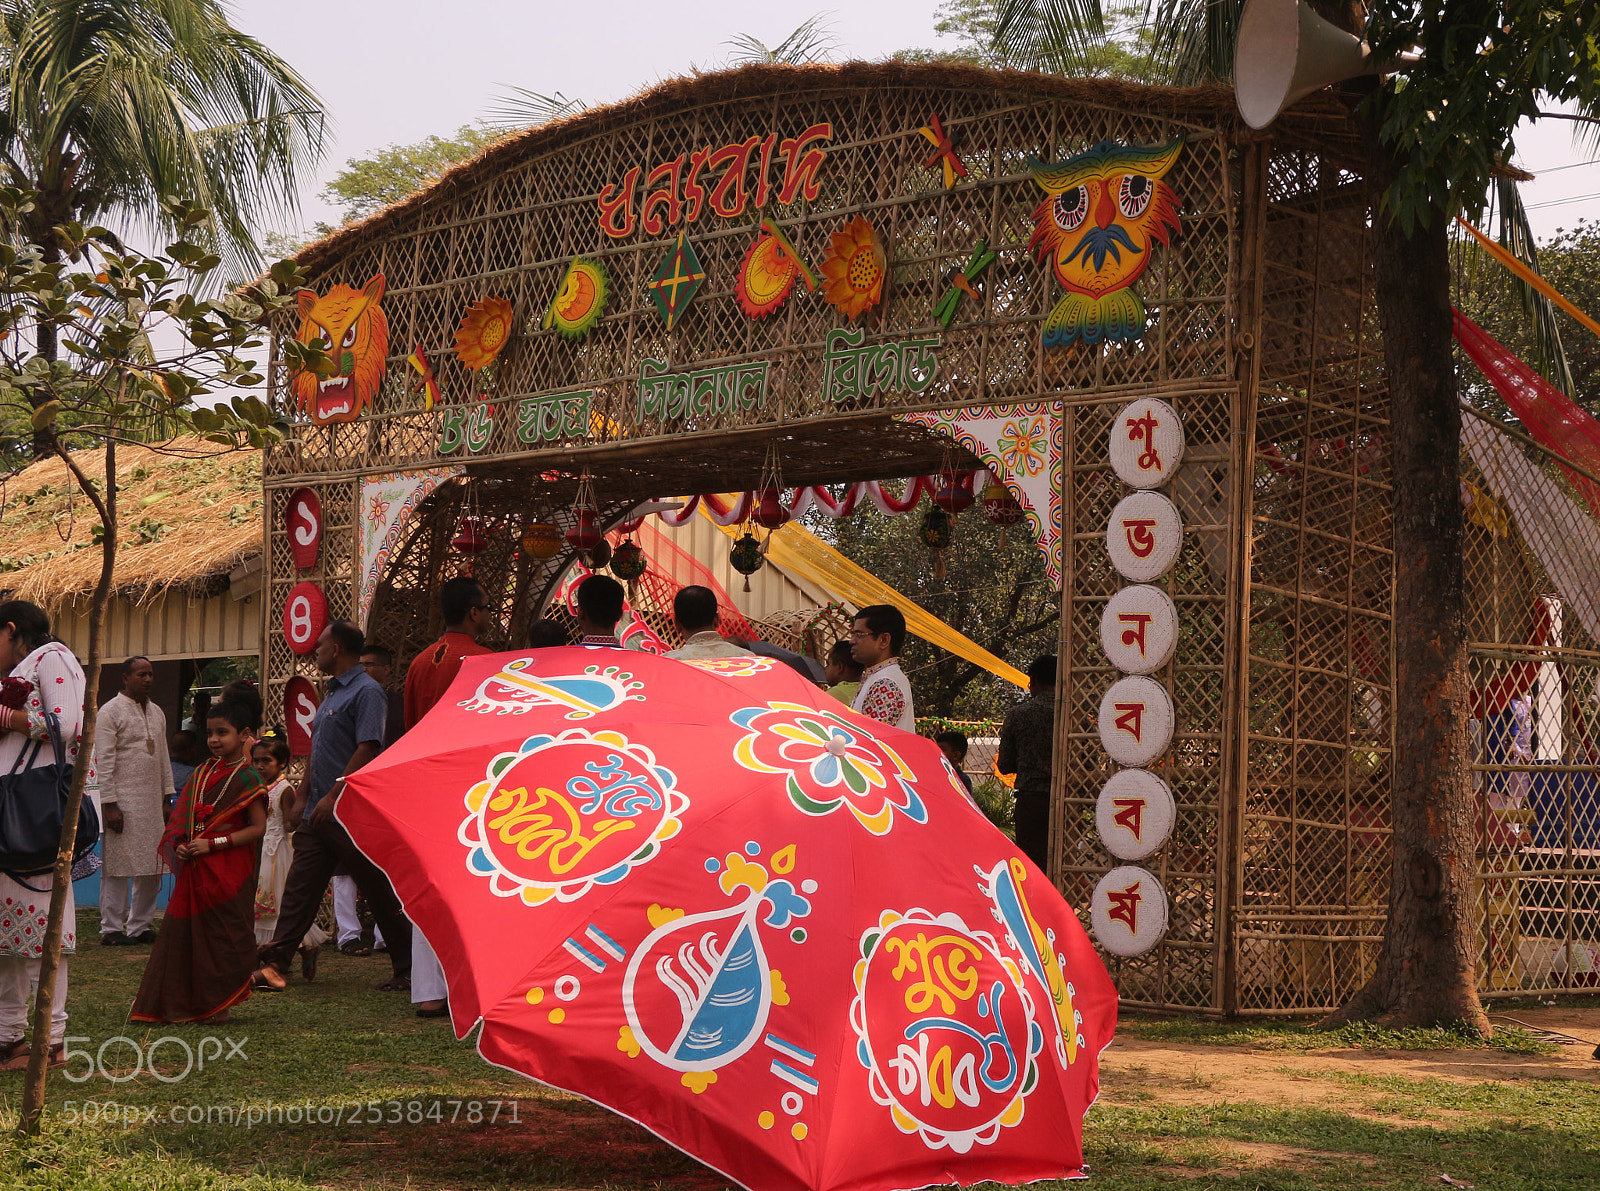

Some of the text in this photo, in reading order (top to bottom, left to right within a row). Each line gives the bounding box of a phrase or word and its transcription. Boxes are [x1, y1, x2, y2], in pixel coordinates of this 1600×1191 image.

[598, 122, 832, 238] ধন্যবাদ
[636, 358, 770, 425] সিগন্যাল
[821, 328, 940, 402] ব্রিগেড
[885, 932, 983, 1016] শুভ
